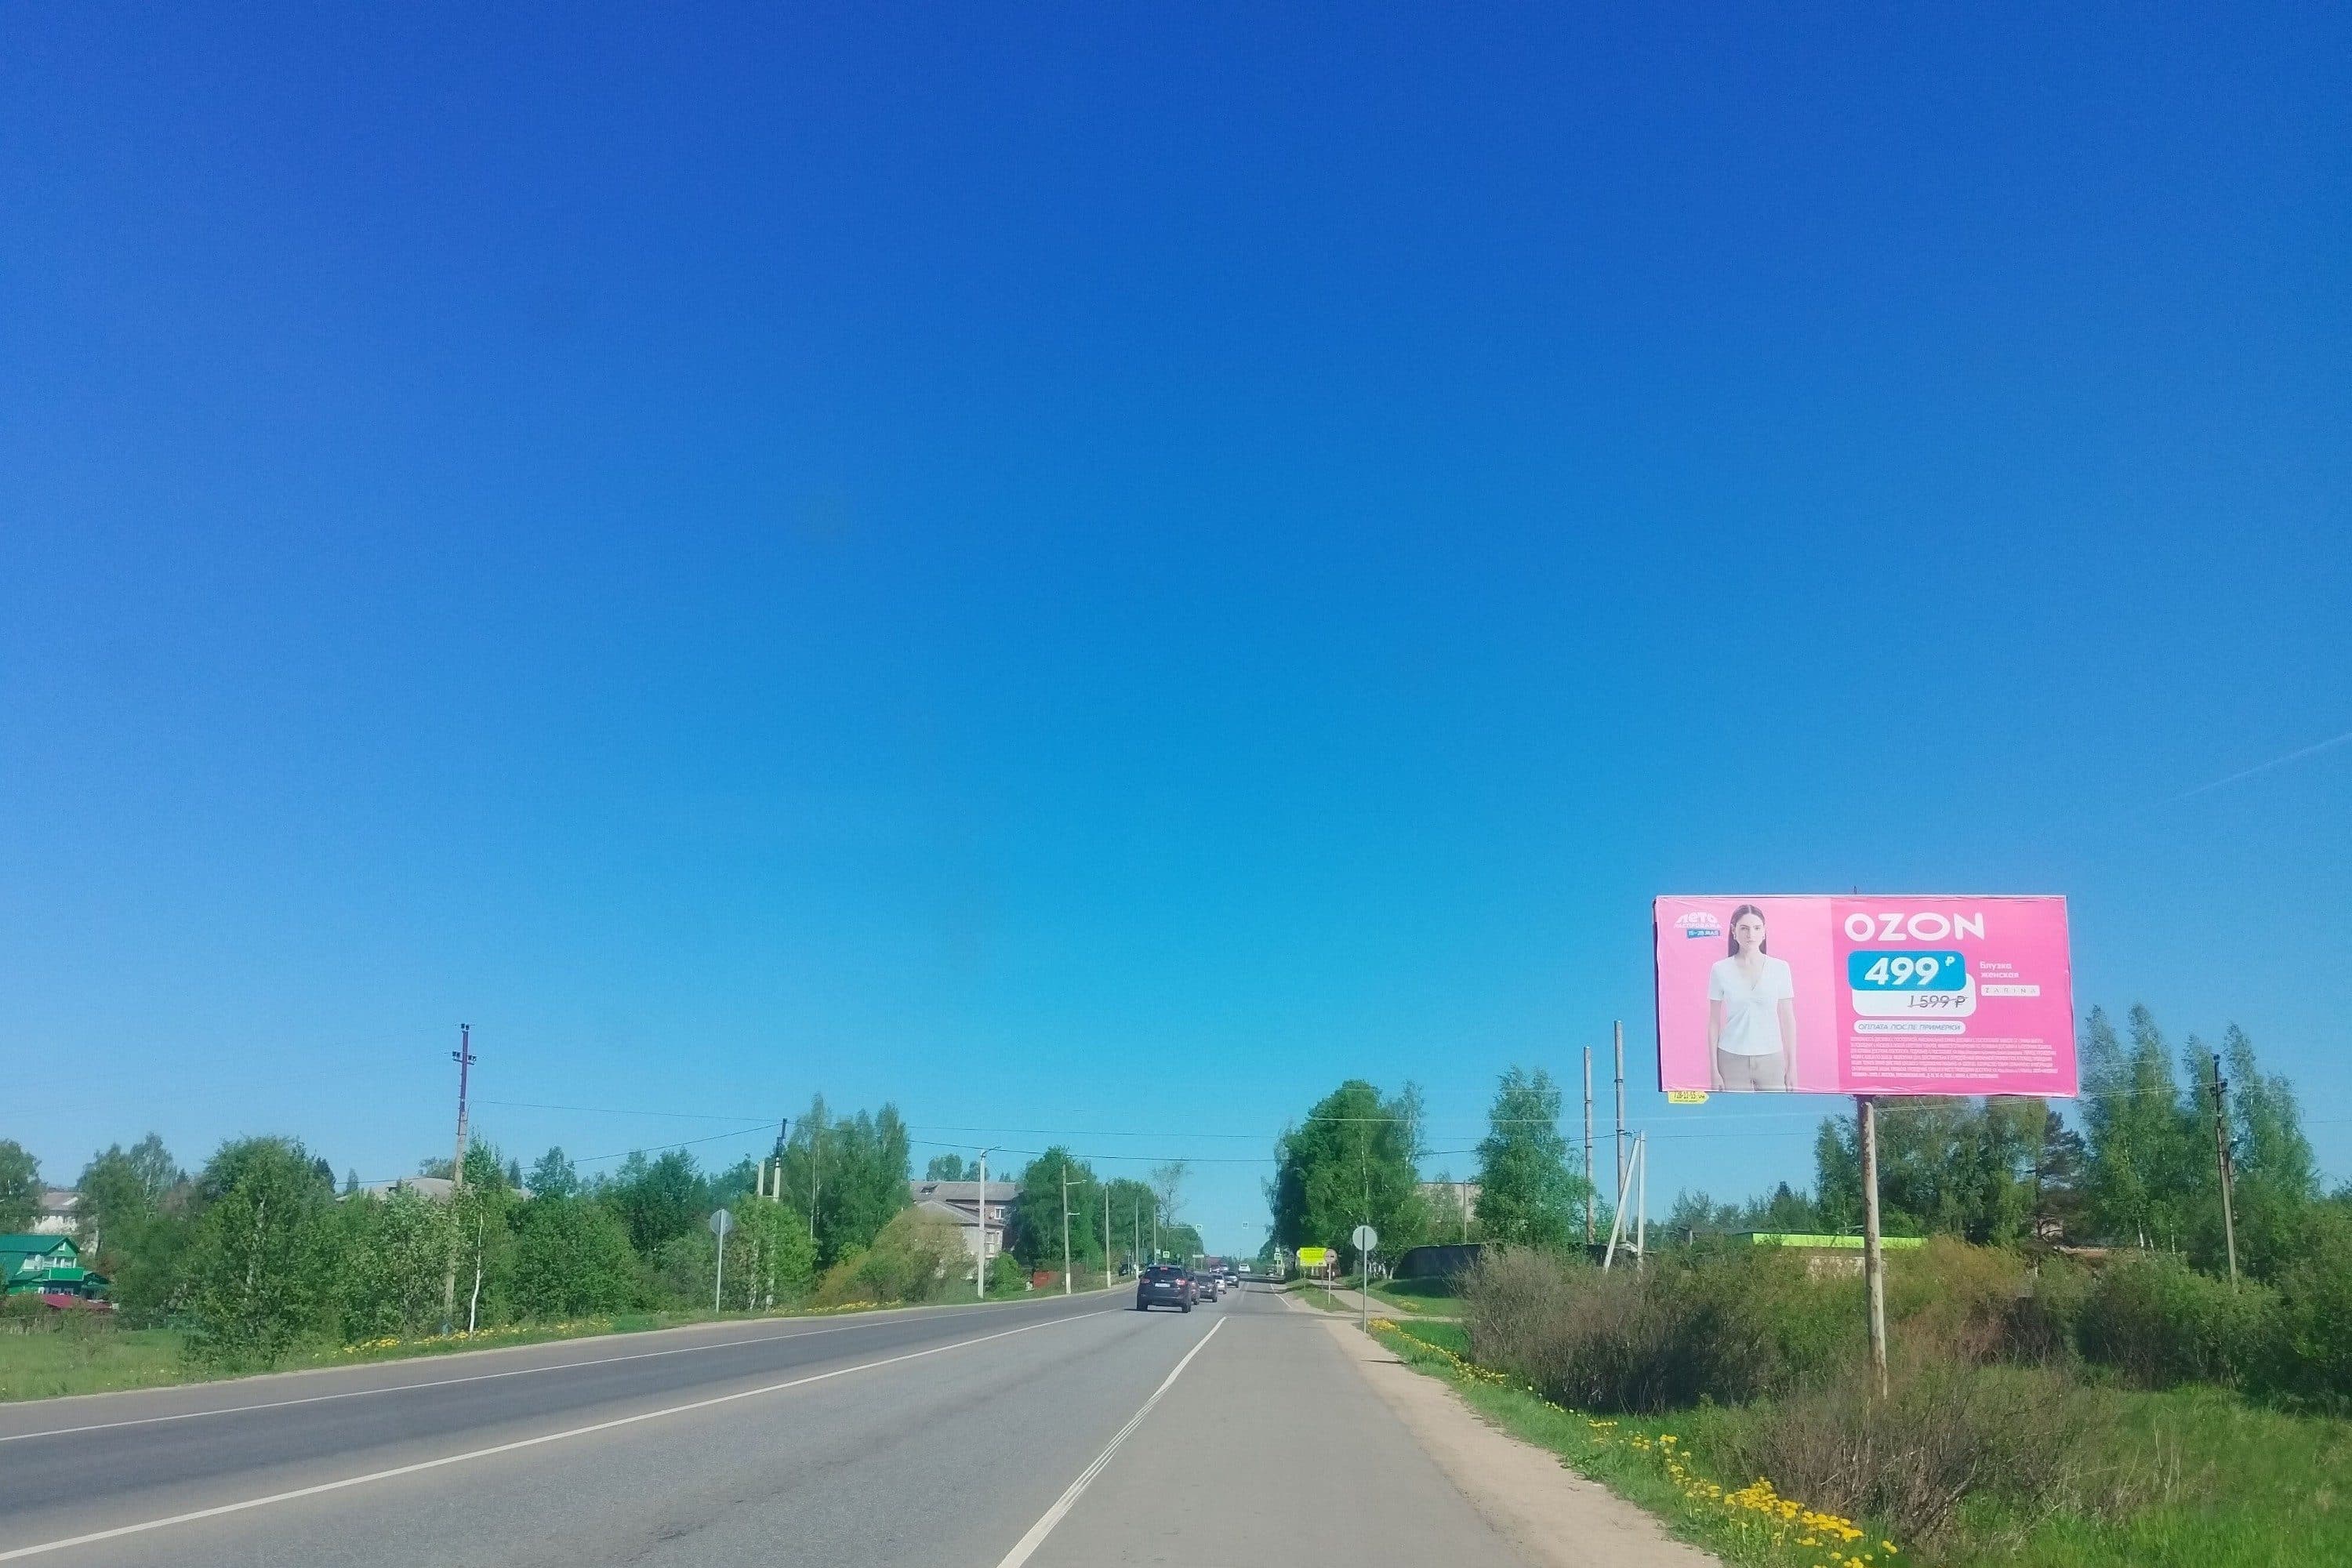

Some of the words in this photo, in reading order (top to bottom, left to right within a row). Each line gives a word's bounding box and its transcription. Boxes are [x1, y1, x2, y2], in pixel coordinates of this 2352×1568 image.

[1844, 912, 1985, 942] OZON
[1864, 956, 1940, 985] 499
[1979, 961, 2013, 971] Блузка
